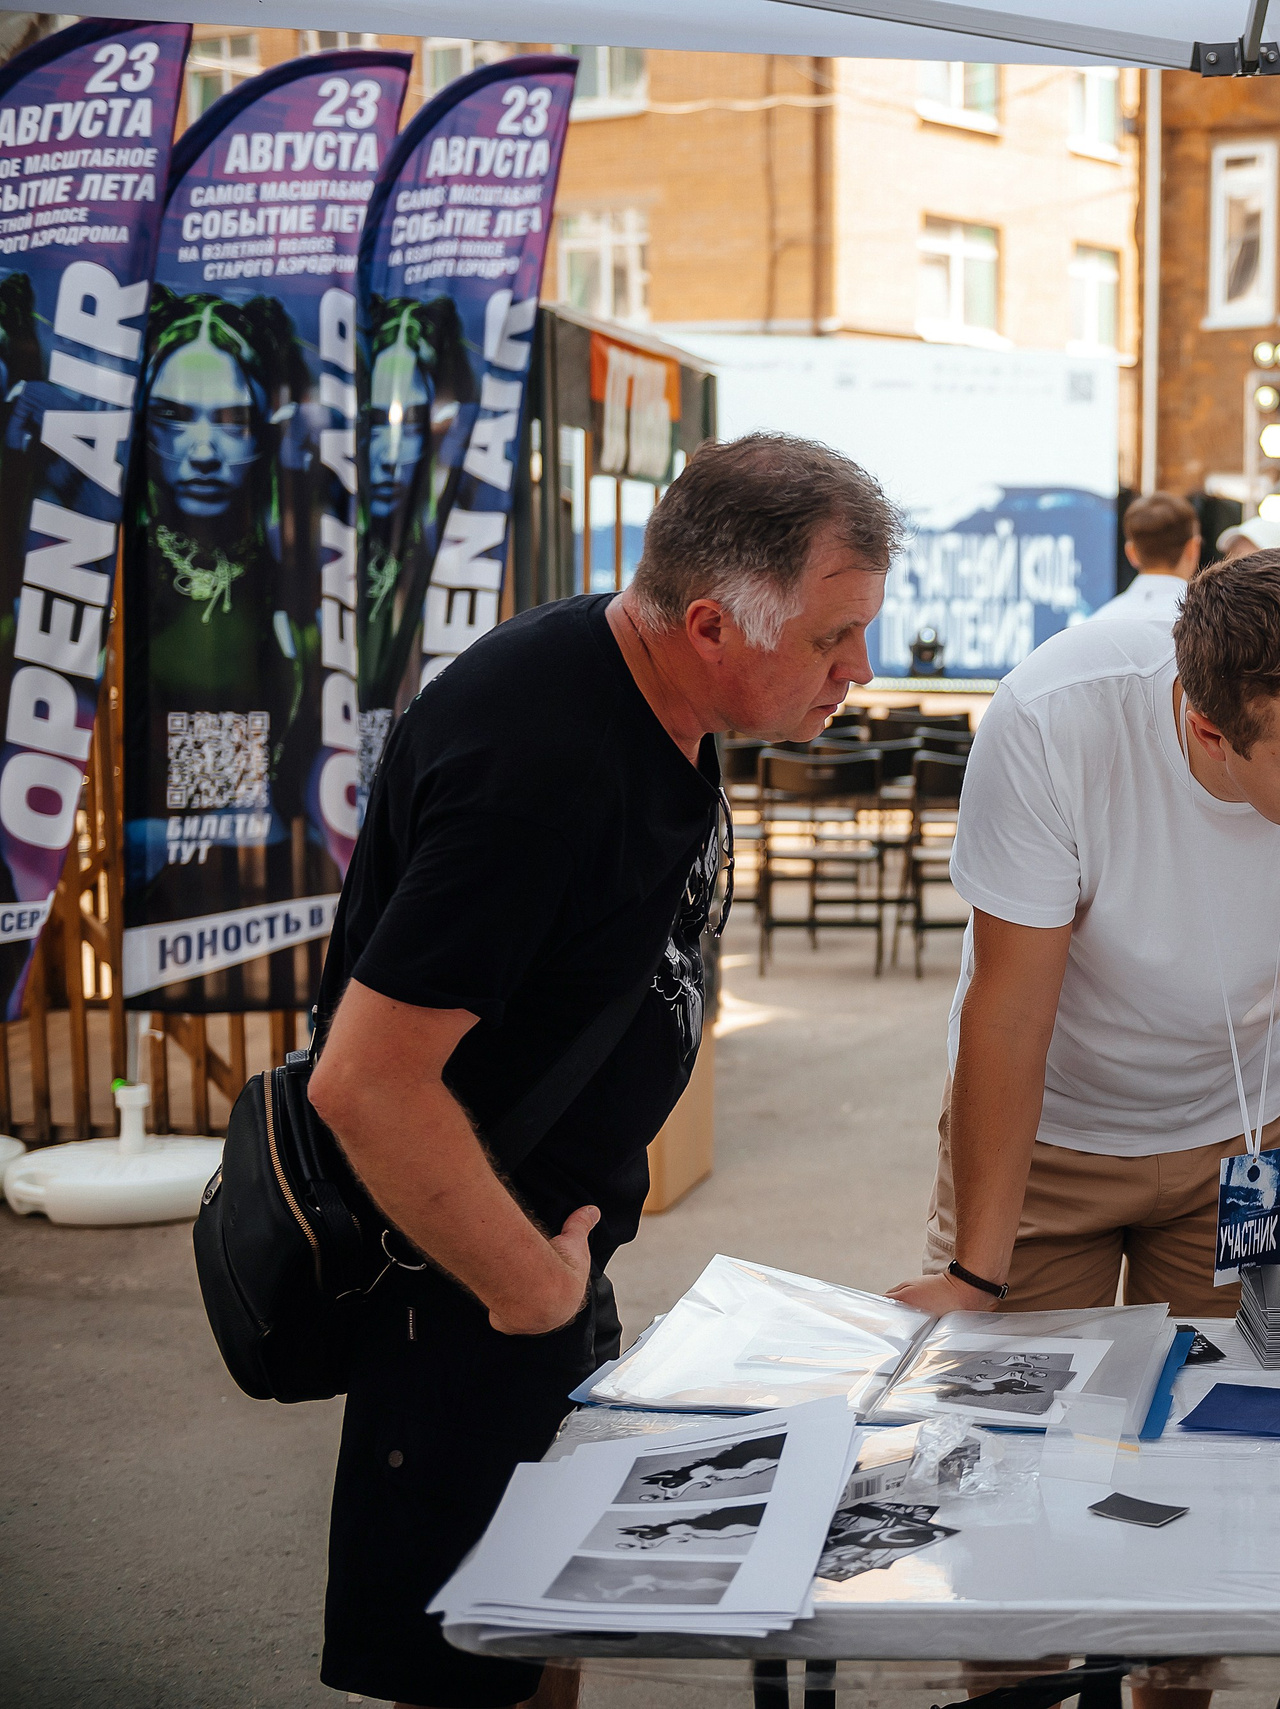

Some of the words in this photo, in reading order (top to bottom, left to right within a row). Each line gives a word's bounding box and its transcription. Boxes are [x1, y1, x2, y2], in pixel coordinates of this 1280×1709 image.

[84, 41, 160, 94] 23
[0, 97, 153, 148] АВГУСТА
[312, 77, 382, 129] 23
[496, 85, 553, 138] 23
[23, 147, 159, 175] МАСШТАБНОЕ
[223, 130, 380, 175] АВГУСТА
[426, 135, 550, 179] АВГУСТА
[76, 173, 157, 202] ЛЕТА
[190, 182, 258, 208] САМОЕ
[30, 225, 130, 249] АЭРОДРОМА
[34, 206, 90, 228] ПОЛОСЕ
[181, 203, 317, 242] СОБЫТИЕ
[177, 246, 199, 263] НА
[203, 258, 275, 282] СТАРОГО
[40, 260, 150, 498] AIR
[0, 497, 118, 851] OPEN
[166, 812, 272, 841] БИЛЕТЫ
[166, 839, 211, 866] ТУТ
[158, 910, 302, 972] ЮНОСТЬ
[308, 905, 324, 928] В
[1220, 1214, 1279, 1262] УЧАСТНИК
